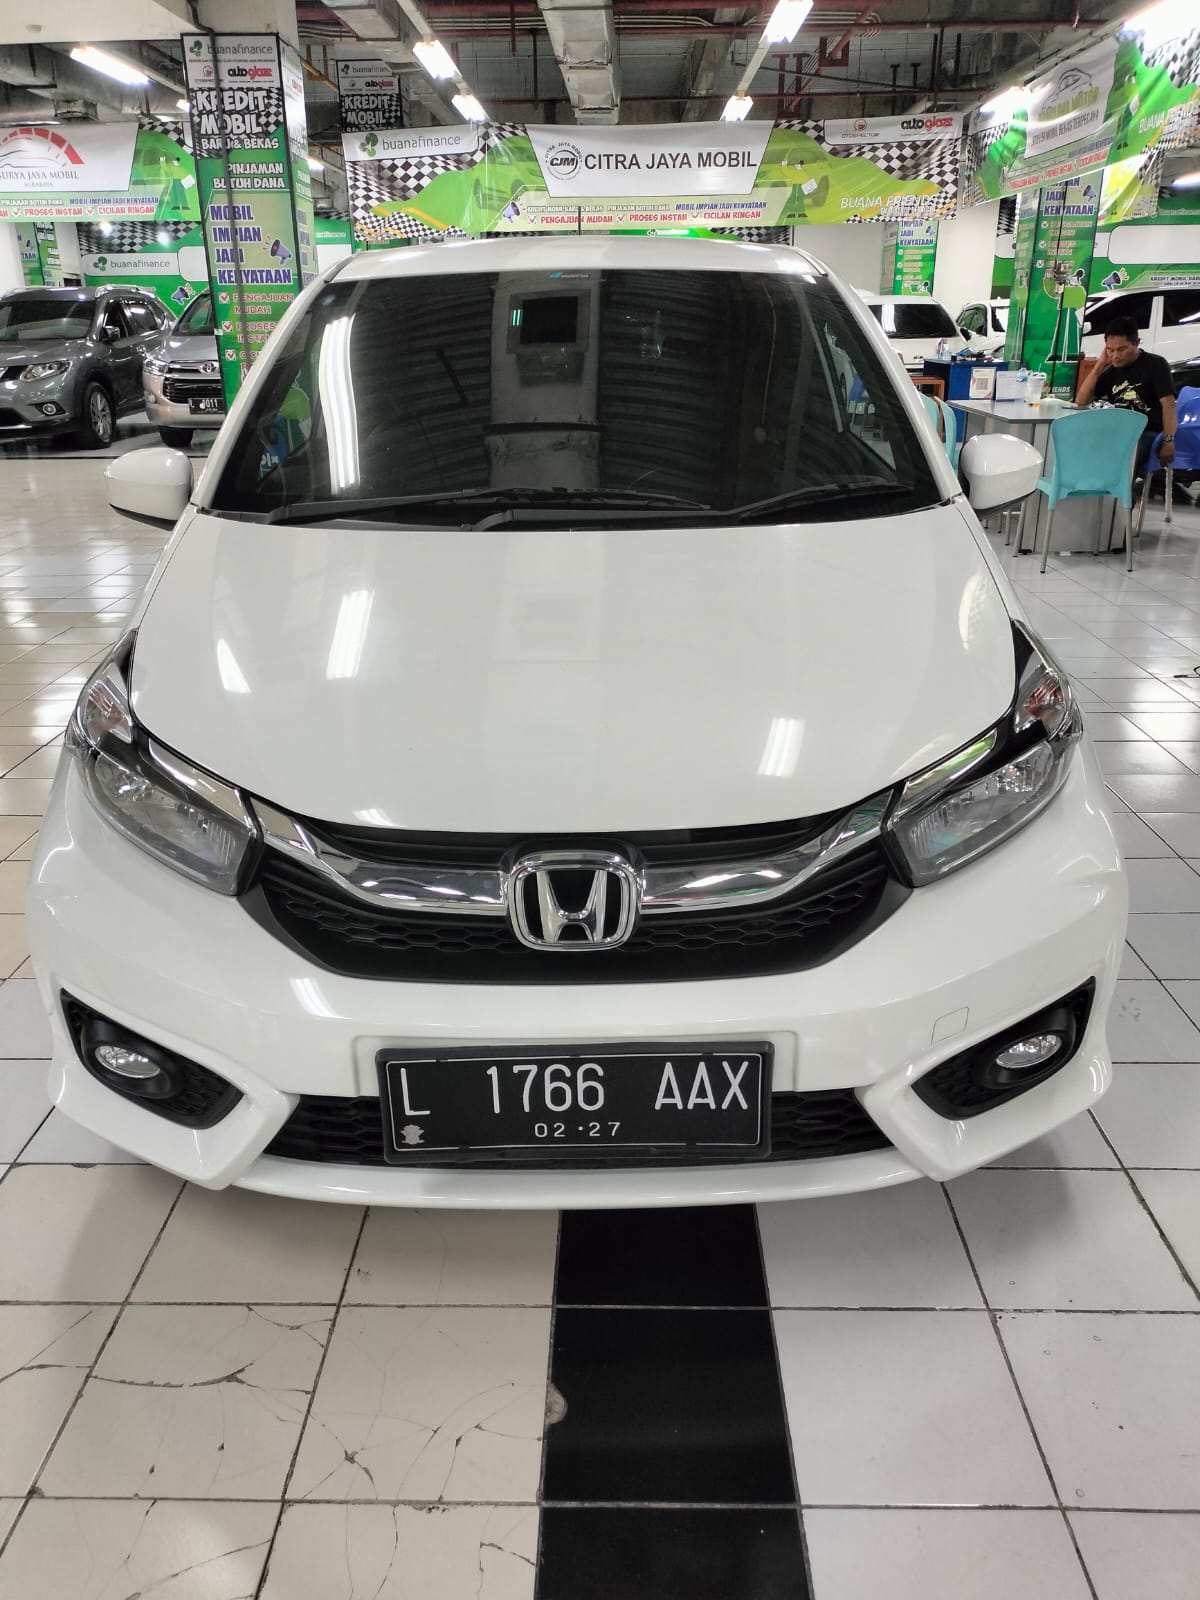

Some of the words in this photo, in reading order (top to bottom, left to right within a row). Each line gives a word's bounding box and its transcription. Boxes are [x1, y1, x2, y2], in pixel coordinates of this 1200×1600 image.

[344, 96, 390, 109] KREDIT
[346, 111, 386, 125] MOBIL
[244, 138, 279, 149] BEKAS
[382, 135, 461, 151] buanafinance
[550, 157, 575, 167] CJM
[584, 153, 641, 170] CITRA
[646, 152, 692, 169] JAYA
[697, 151, 757, 168] MOBIL
[27, 171, 47, 180] JAYA
[50, 170, 79, 179] MOBIL
[254, 178, 285, 188] DANA
[840, 196, 882, 208] BUANA
[24, 208, 53, 216] PROSES
[541, 216, 584, 224] PENGAJUAN
[587, 215, 613, 223] MUDAH
[660, 213, 687, 221] INSTAN
[110, 257, 171, 268] buanafinance
[400, 1067, 431, 1116] L
[486, 1062, 605, 1114] 1766
[654, 1060, 749, 1111] AAX
